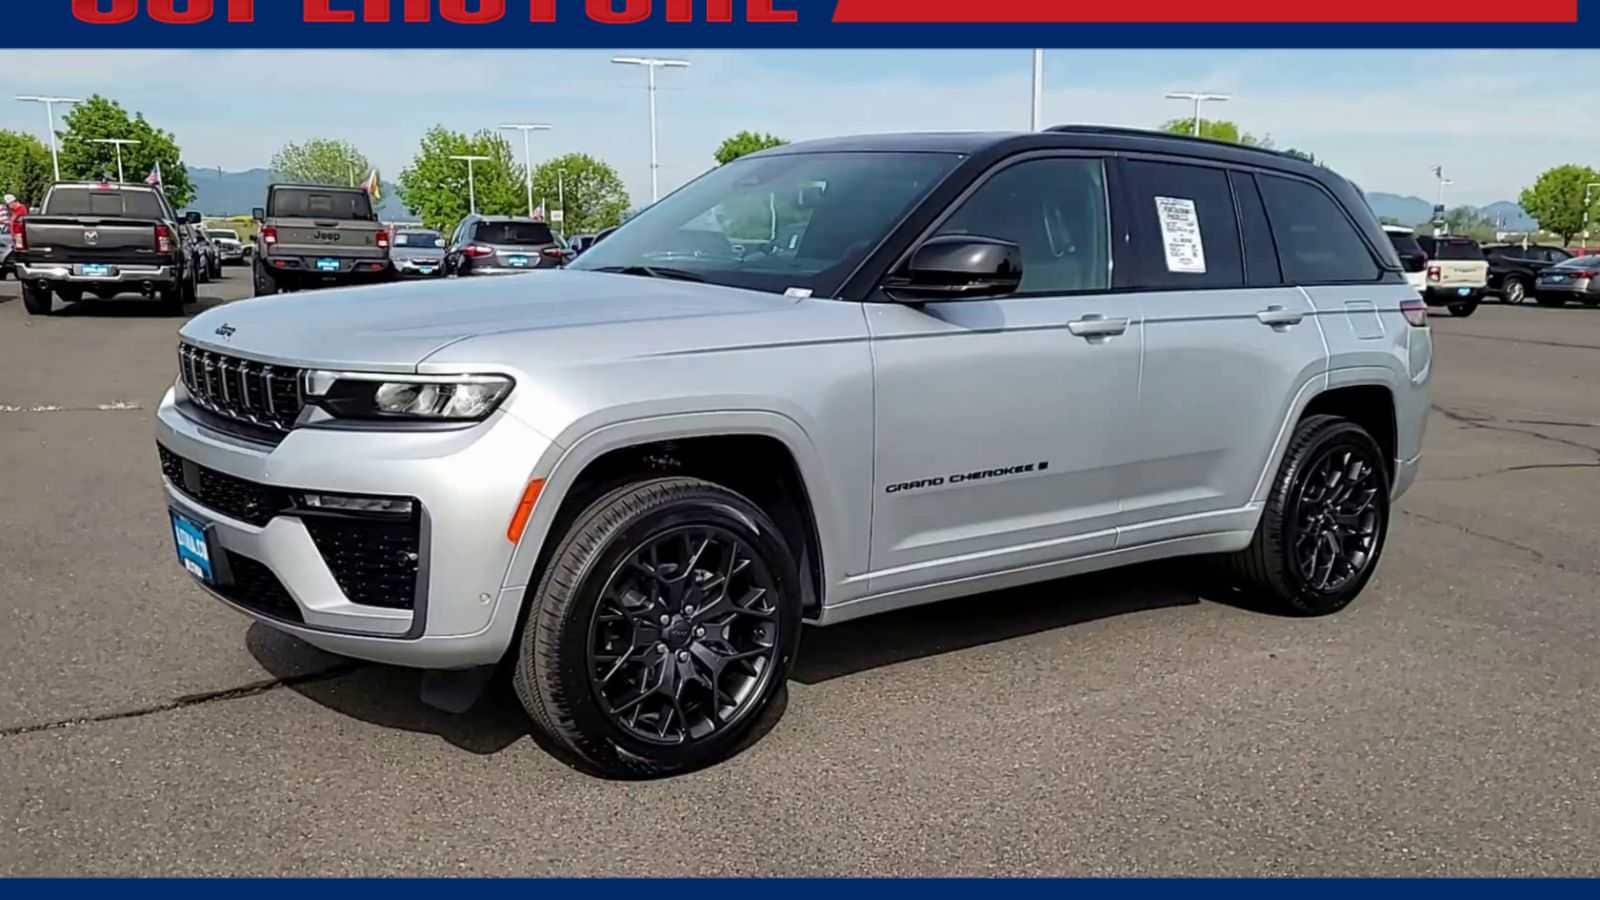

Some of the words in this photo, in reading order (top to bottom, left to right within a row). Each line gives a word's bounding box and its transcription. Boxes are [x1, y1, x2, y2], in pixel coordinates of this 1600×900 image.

[313, 231, 341, 241] Jeep
[885, 477, 944, 493] GRAND
[949, 464, 1034, 484] CHEROKEE
